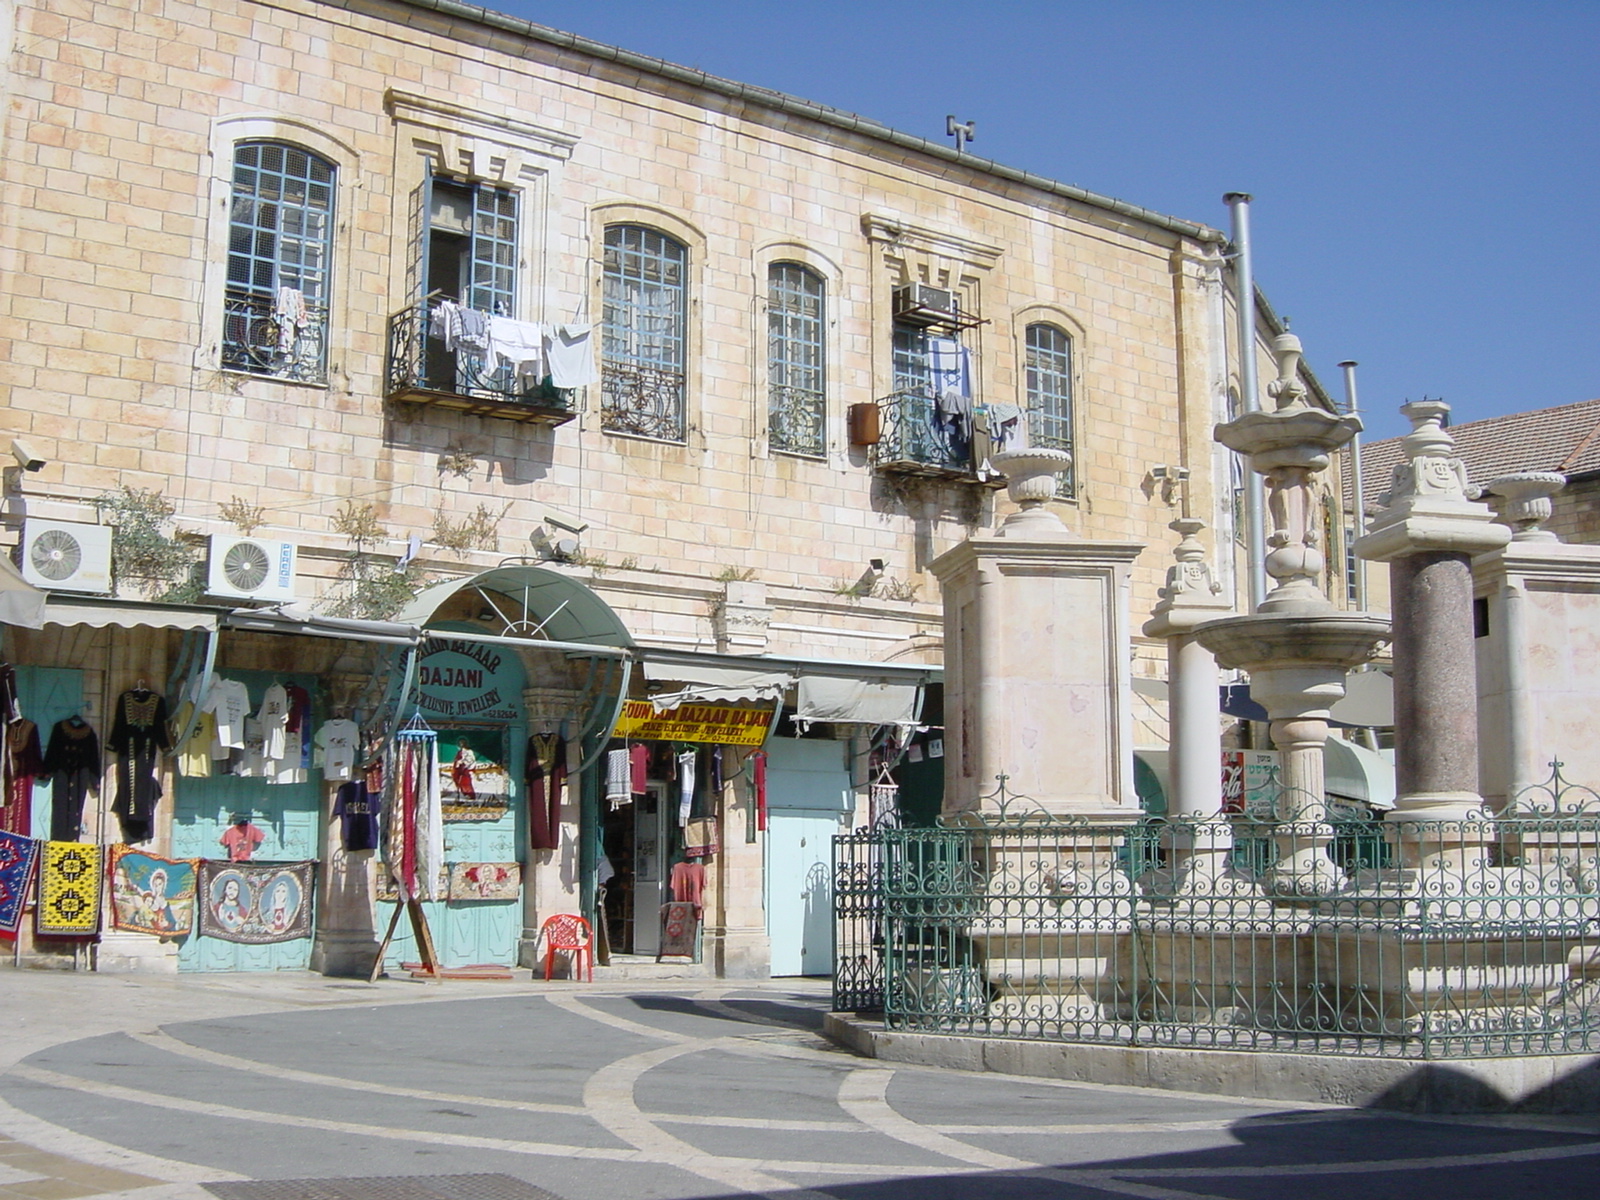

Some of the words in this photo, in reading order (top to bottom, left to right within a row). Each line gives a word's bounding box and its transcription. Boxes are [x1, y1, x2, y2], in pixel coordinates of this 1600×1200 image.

[420, 666, 483, 688] DAJANI
[456, 687, 502, 716] JEWELLERY
[680, 706, 728, 725] BAZAAR
[700, 725, 745, 736] JEWELLERY
